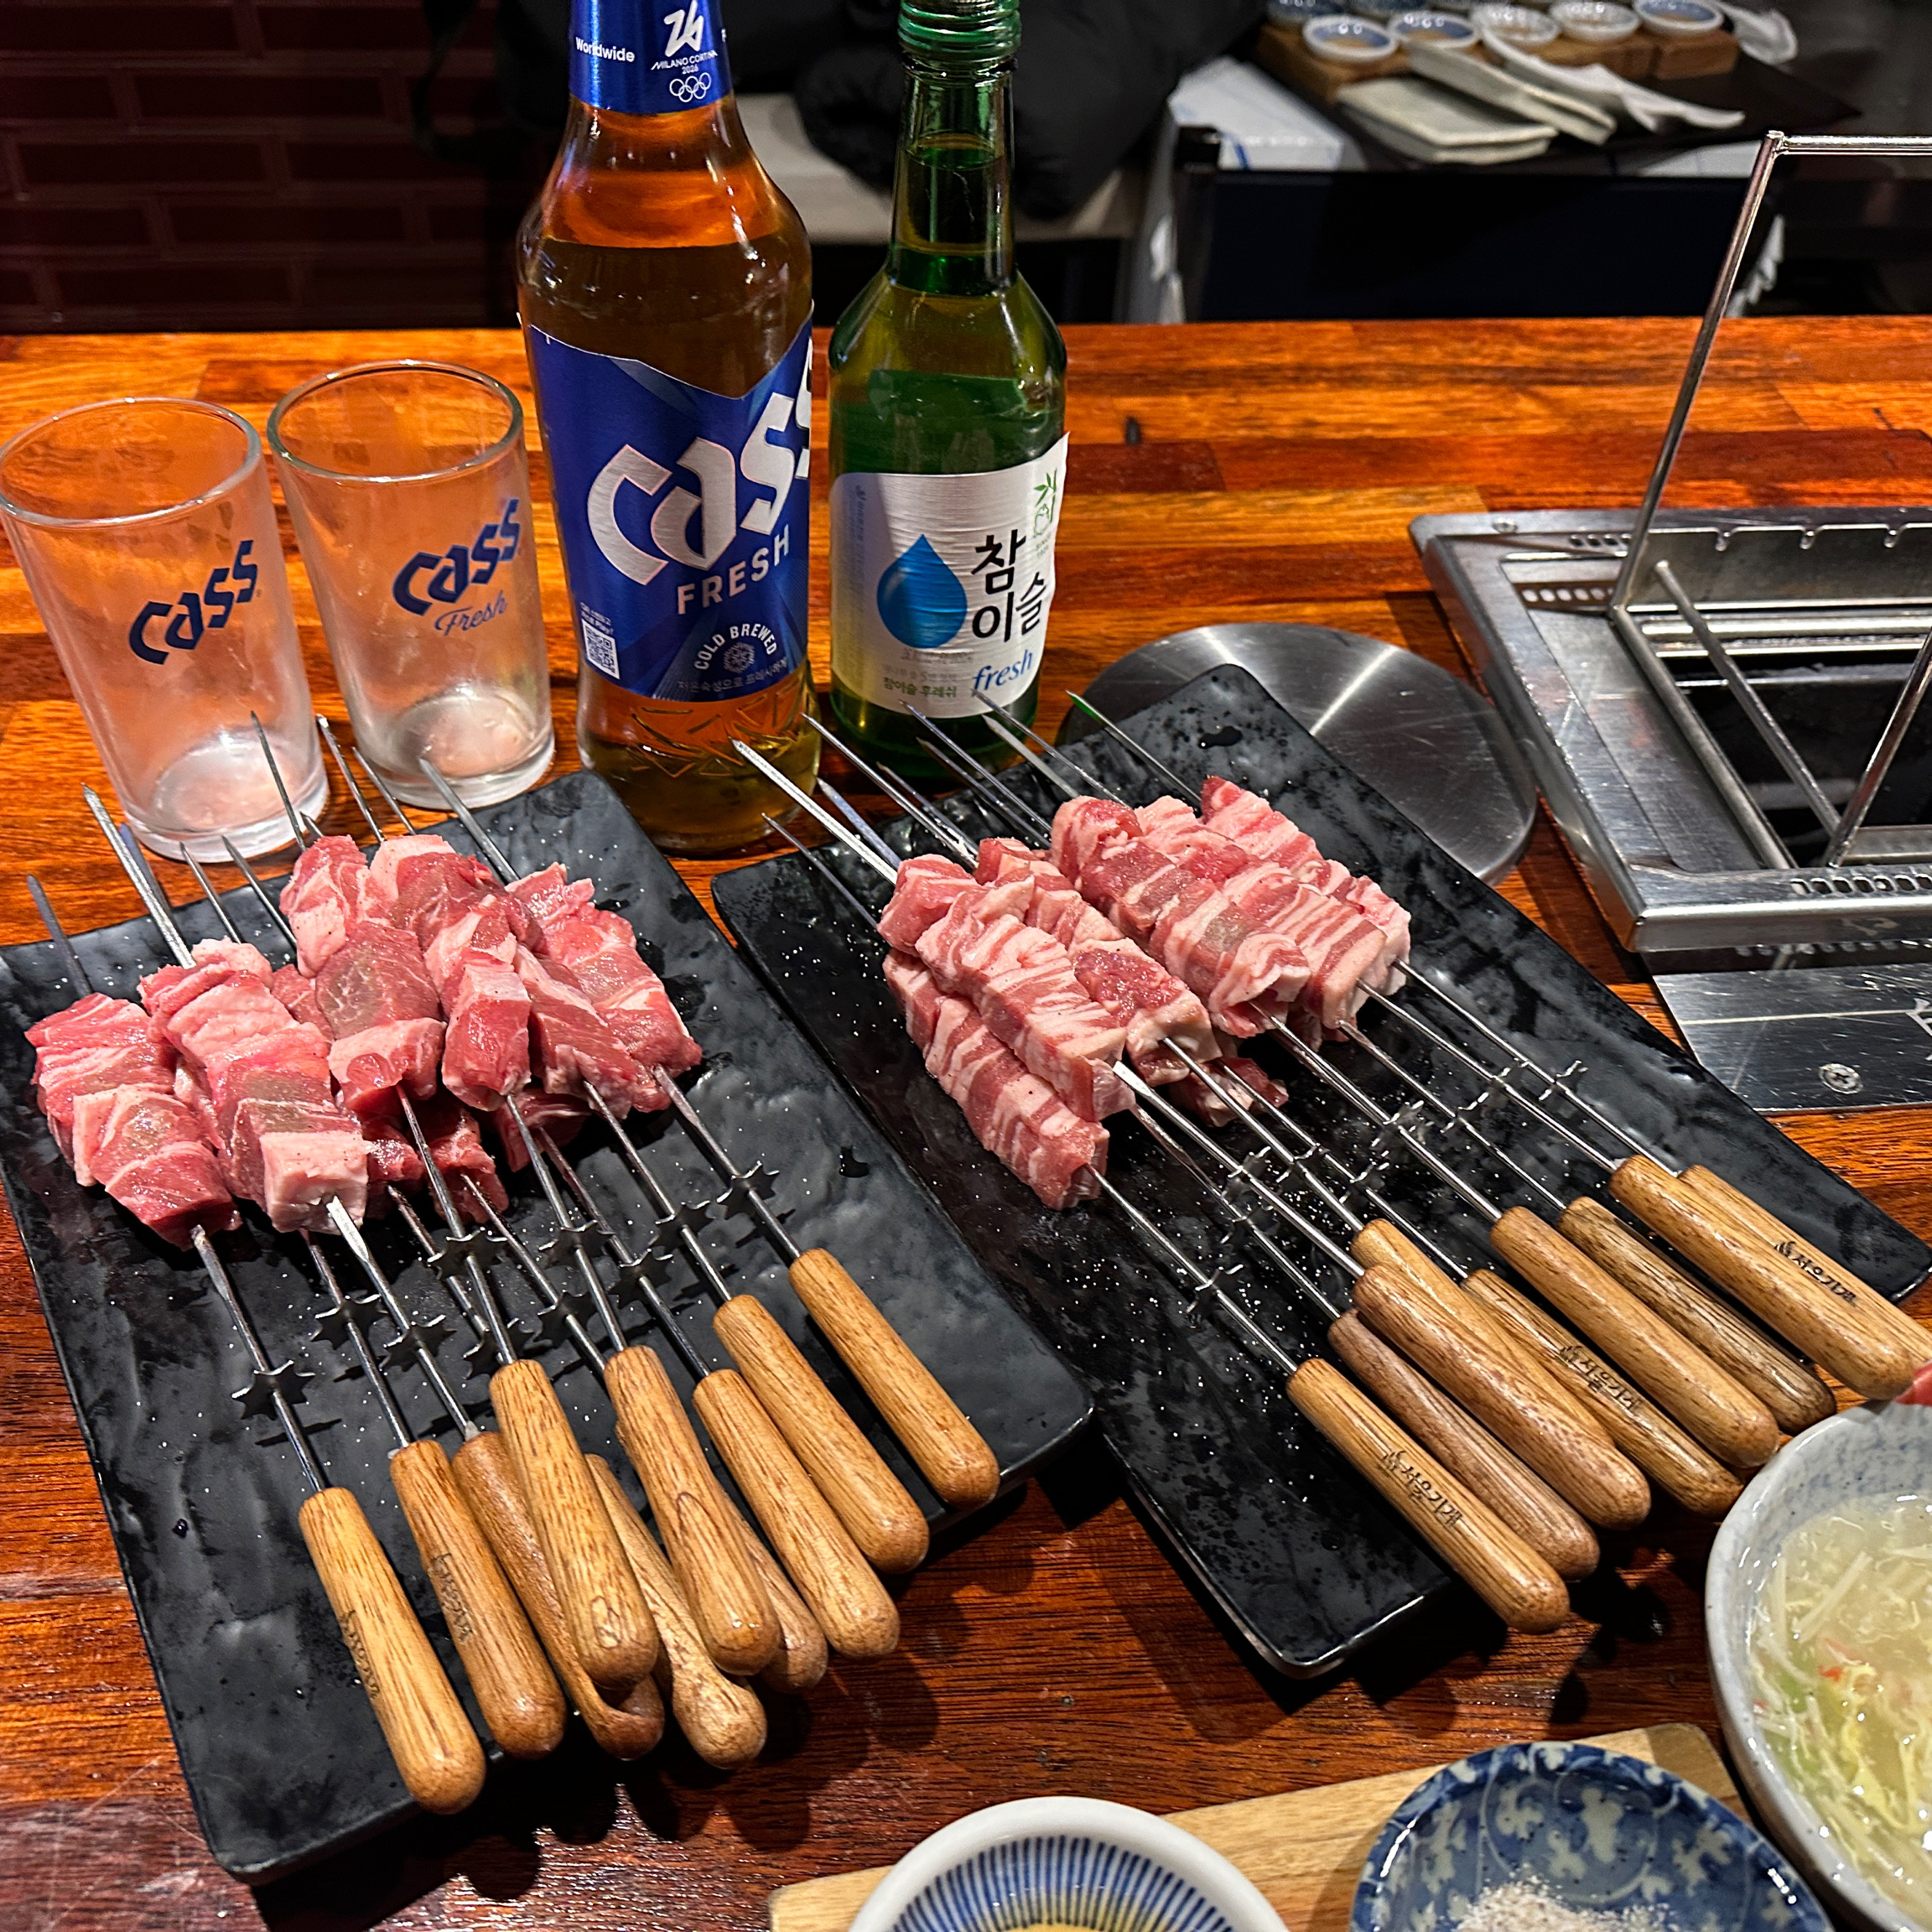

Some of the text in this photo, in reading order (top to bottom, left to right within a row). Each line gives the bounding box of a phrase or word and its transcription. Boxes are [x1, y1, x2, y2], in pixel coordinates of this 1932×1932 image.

[575, 36, 635, 63] Worldwide
[651, 49, 719, 70] MILANO CORTINA
[682, 64, 699, 75] 2026
[678, 525, 791, 615] FRESH
[434, 589, 508, 636] Fresh
[693, 623, 777, 670] COLD BREWED
[883, 677, 958, 699] 참이슬 후레쉬
[972, 648, 1033, 698] fresh
